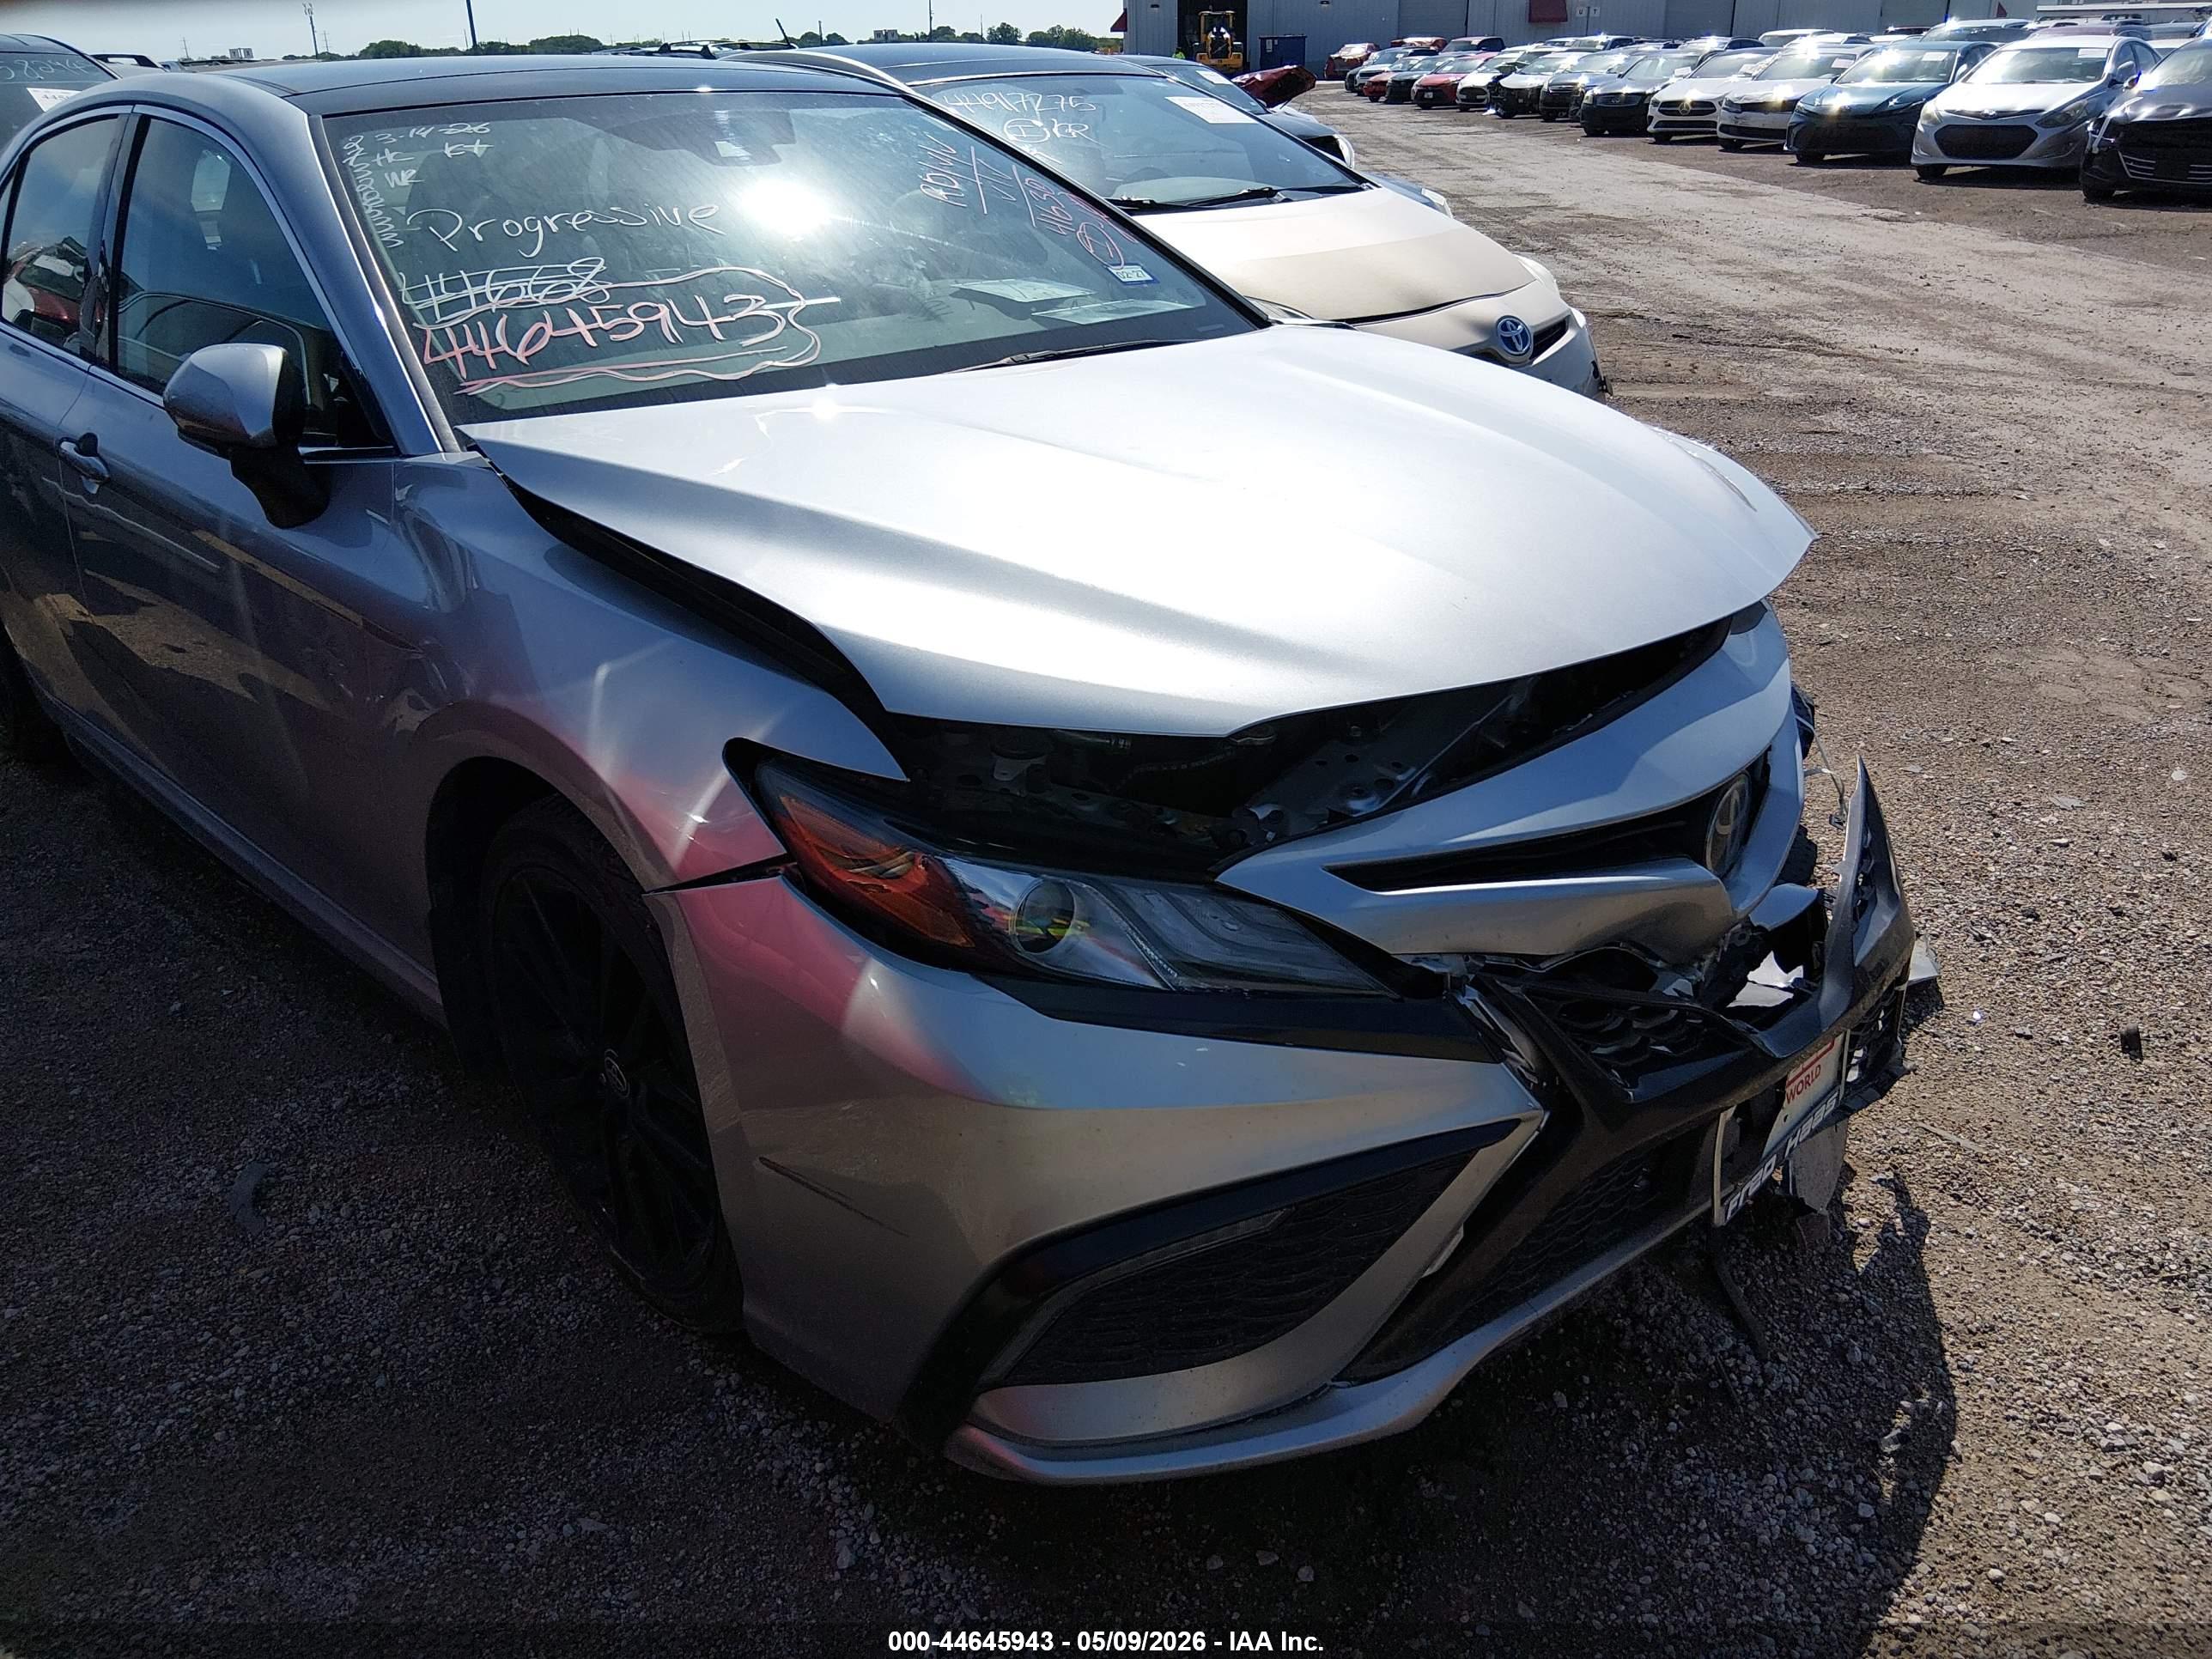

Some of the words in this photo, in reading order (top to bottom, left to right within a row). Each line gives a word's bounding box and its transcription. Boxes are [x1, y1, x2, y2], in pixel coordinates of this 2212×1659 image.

[407, 205, 726, 258] Progressive
[423, 293, 787, 380] 44645943
[1785, 1064, 1821, 1105] WORLD
